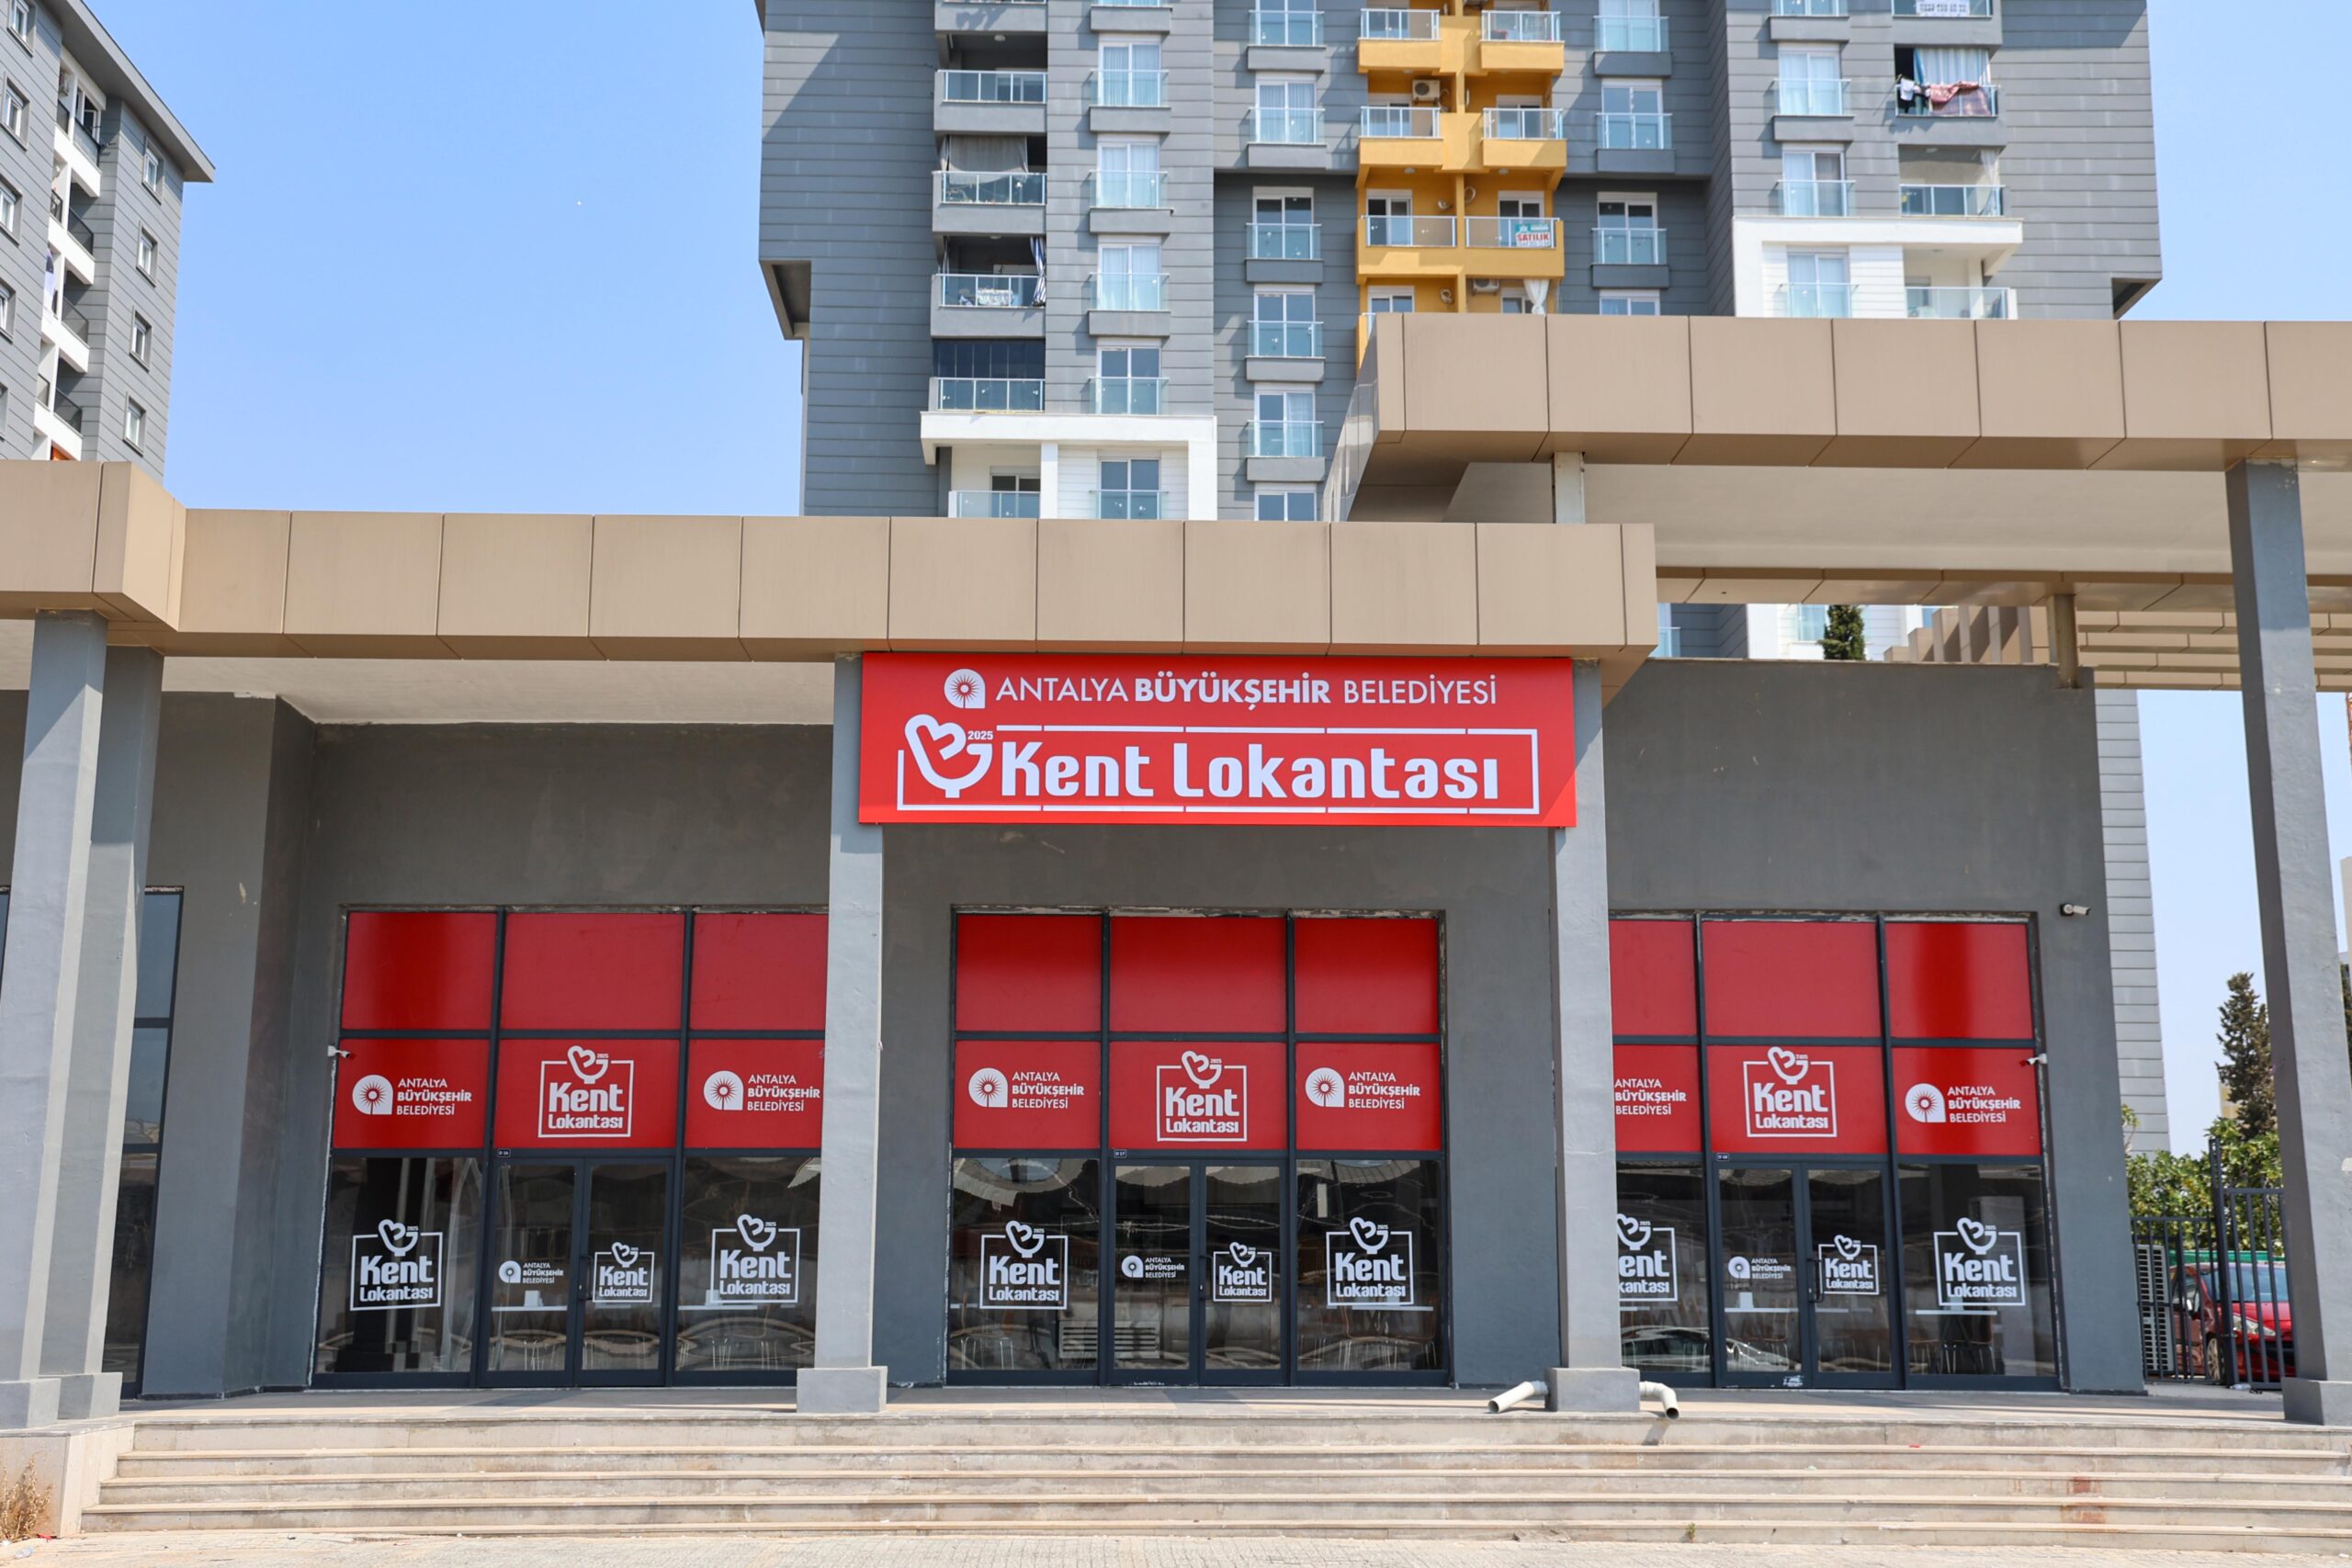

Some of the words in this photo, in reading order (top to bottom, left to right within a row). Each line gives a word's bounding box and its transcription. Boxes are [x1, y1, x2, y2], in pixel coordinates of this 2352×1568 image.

[996, 678, 1128, 701] ANTALYA
[1136, 671, 1330, 710] BÜYÜKŞEHİR
[1345, 674, 1496, 704] BELEDİYESİ
[968, 731, 993, 739] 2025
[1002, 742, 1153, 796] Kent
[1174, 743, 1498, 799] Lokantası
[399, 1078, 447, 1088] ANTALYA
[748, 1075, 796, 1084] ANTALYA
[1012, 1072, 1060, 1081] ANTALYA
[1349, 1072, 1396, 1081] ANTALYA
[1614, 1078, 1661, 1088] ANTALYA
[398, 1089, 471, 1103] BÜYÜKŞEHİR
[549, 1082, 624, 1111] Kent
[748, 1086, 820, 1100] BÜYÜKŞEHİR
[1012, 1083, 1084, 1097] BÜYÜKŞEHİR
[1349, 1083, 1419, 1097] BÜYÜKŞEHİR
[1615, 1089, 1686, 1103] BÜYÜKŞEHİR
[1754, 1083, 1828, 1111] Kent
[1948, 1087, 1996, 1095] ANTALYA
[397, 1103, 455, 1115] BELEDİYESİ
[748, 1100, 804, 1111] BELEDİYESİ
[1012, 1097, 1068, 1108] BELEDİYESİ
[1166, 1088, 1239, 1116] Kent
[1349, 1097, 1404, 1109] BELEDİYESİ
[1616, 1103, 1671, 1115] BELEDİYESİ
[1949, 1097, 2020, 1111] BÜYÜKŞEHİR
[548, 1114, 623, 1128] Lokantası
[1756, 1113, 1828, 1128] Lokantası
[1950, 1111, 2006, 1122] BELEDİYESİ
[1167, 1118, 1238, 1133] Lokantası
[360, 1256, 434, 1285] Kent
[720, 1250, 791, 1279] Kent
[989, 1256, 1060, 1284] Kent
[1336, 1253, 1406, 1280] Kent
[1619, 1249, 1669, 1278] ent
[1826, 1258, 1873, 1279] Kent
[1944, 1253, 2017, 1281] Kent
[600, 1266, 649, 1286] Kent
[1219, 1266, 1267, 1285] Kent
[718, 1280, 790, 1296] Lokantası
[1219, 1286, 1266, 1296] Lokantası
[1336, 1282, 1406, 1299] Lokantası
[1619, 1279, 1669, 1293] kantası
[1826, 1279, 1873, 1289] Lokantası
[360, 1286, 433, 1301] Lokantası
[599, 1287, 647, 1297] Lokantası
[989, 1286, 1058, 1301] Lokantası
[1947, 1283, 2018, 1300] Lokantası
